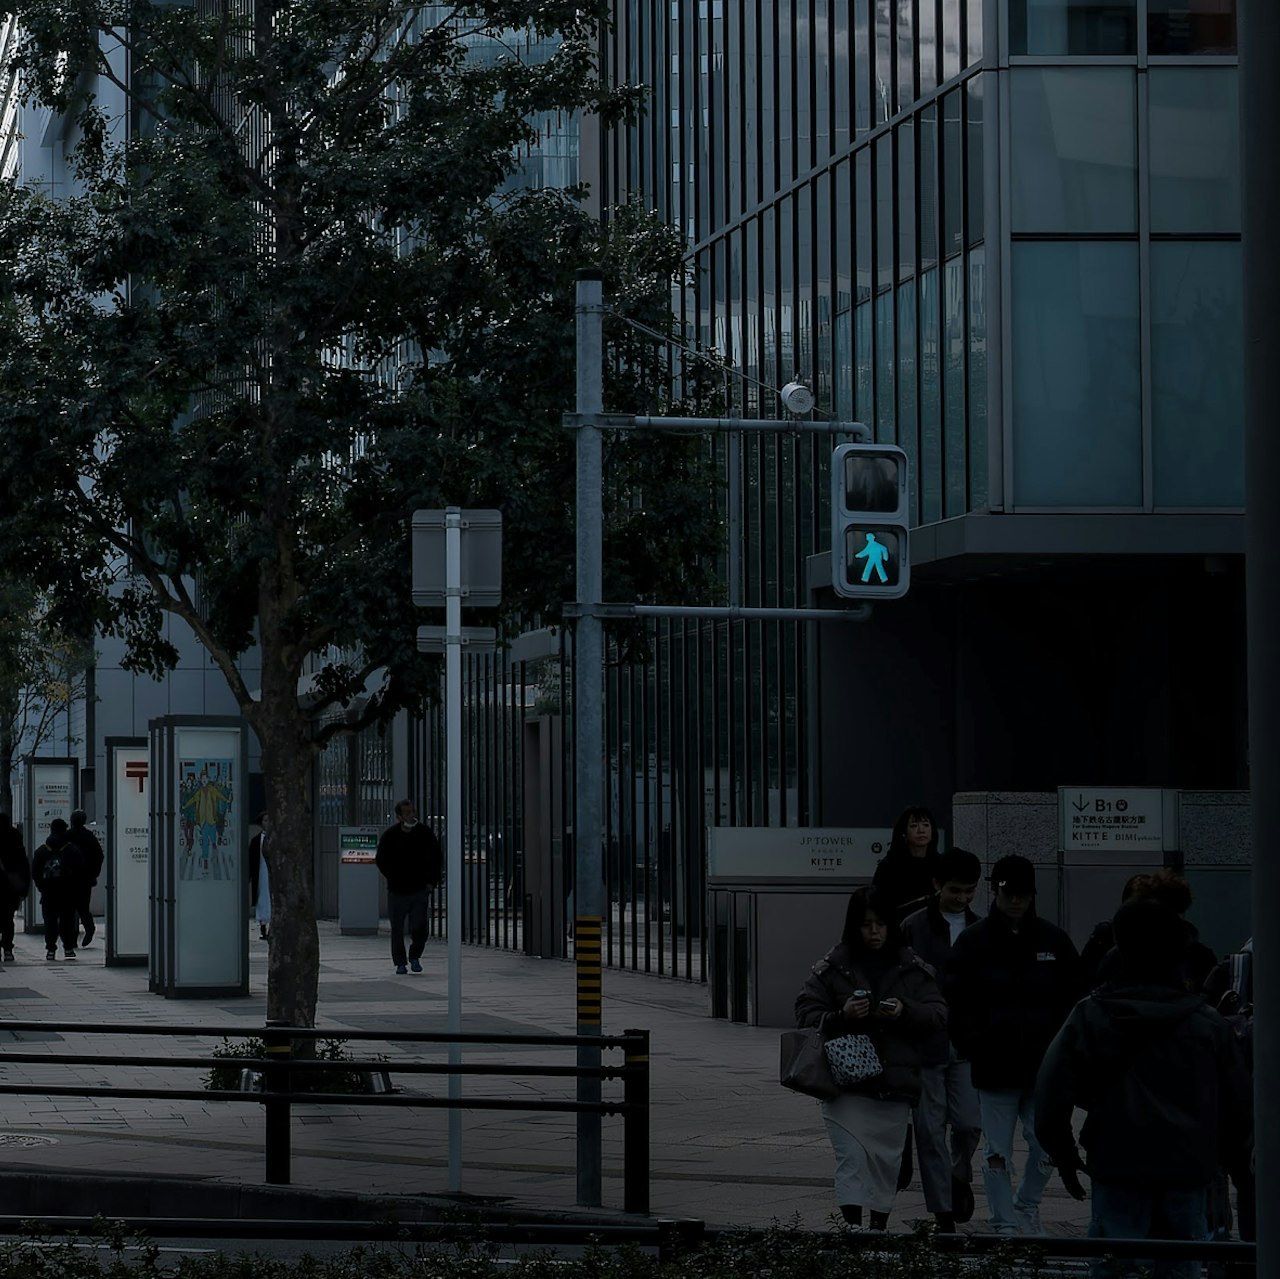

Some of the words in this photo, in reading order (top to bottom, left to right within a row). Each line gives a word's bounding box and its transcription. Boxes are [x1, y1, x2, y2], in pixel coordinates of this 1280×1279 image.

[1072, 815, 1146, 824] 地下鉄名古屋駅方面
[1072, 832, 1108, 841] KITTE
[811, 857, 843, 866] KITTE
